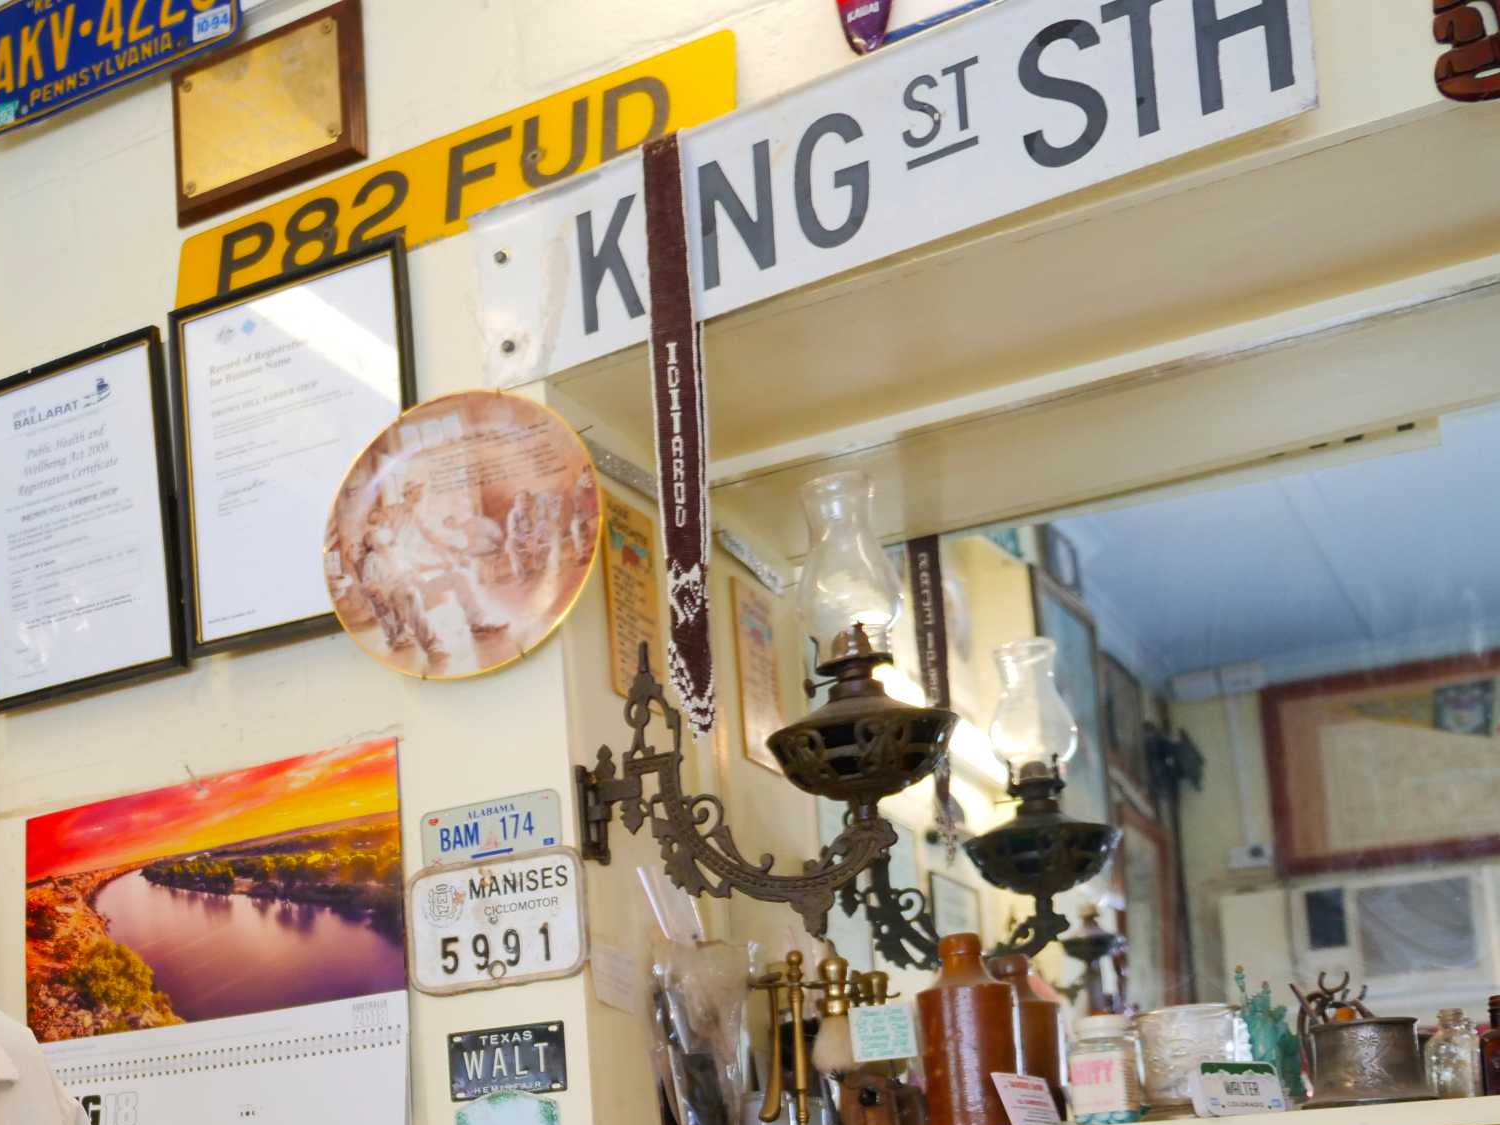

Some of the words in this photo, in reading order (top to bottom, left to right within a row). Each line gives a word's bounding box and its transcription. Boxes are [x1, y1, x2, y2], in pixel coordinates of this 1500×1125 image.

[29, 31, 173, 108] PENNSYLVANIA
[217, 170, 409, 292] P82
[444, 75, 671, 224] FUD
[576, 112, 870, 336] KNG
[902, 56, 979, 149] ST
[1018, 0, 1295, 168] STH
[13, 399, 79, 431] BALLARAT
[467, 803, 515, 820] ALABAMA
[439, 821, 480, 852] BAM
[499, 811, 535, 841] 174
[469, 865, 568, 900] MANISES
[484, 896, 559, 918] CICLOMOTOR
[441, 922, 552, 975] 5991
[479, 1030, 533, 1046] TEXAS
[463, 1042, 549, 1081] WALT
